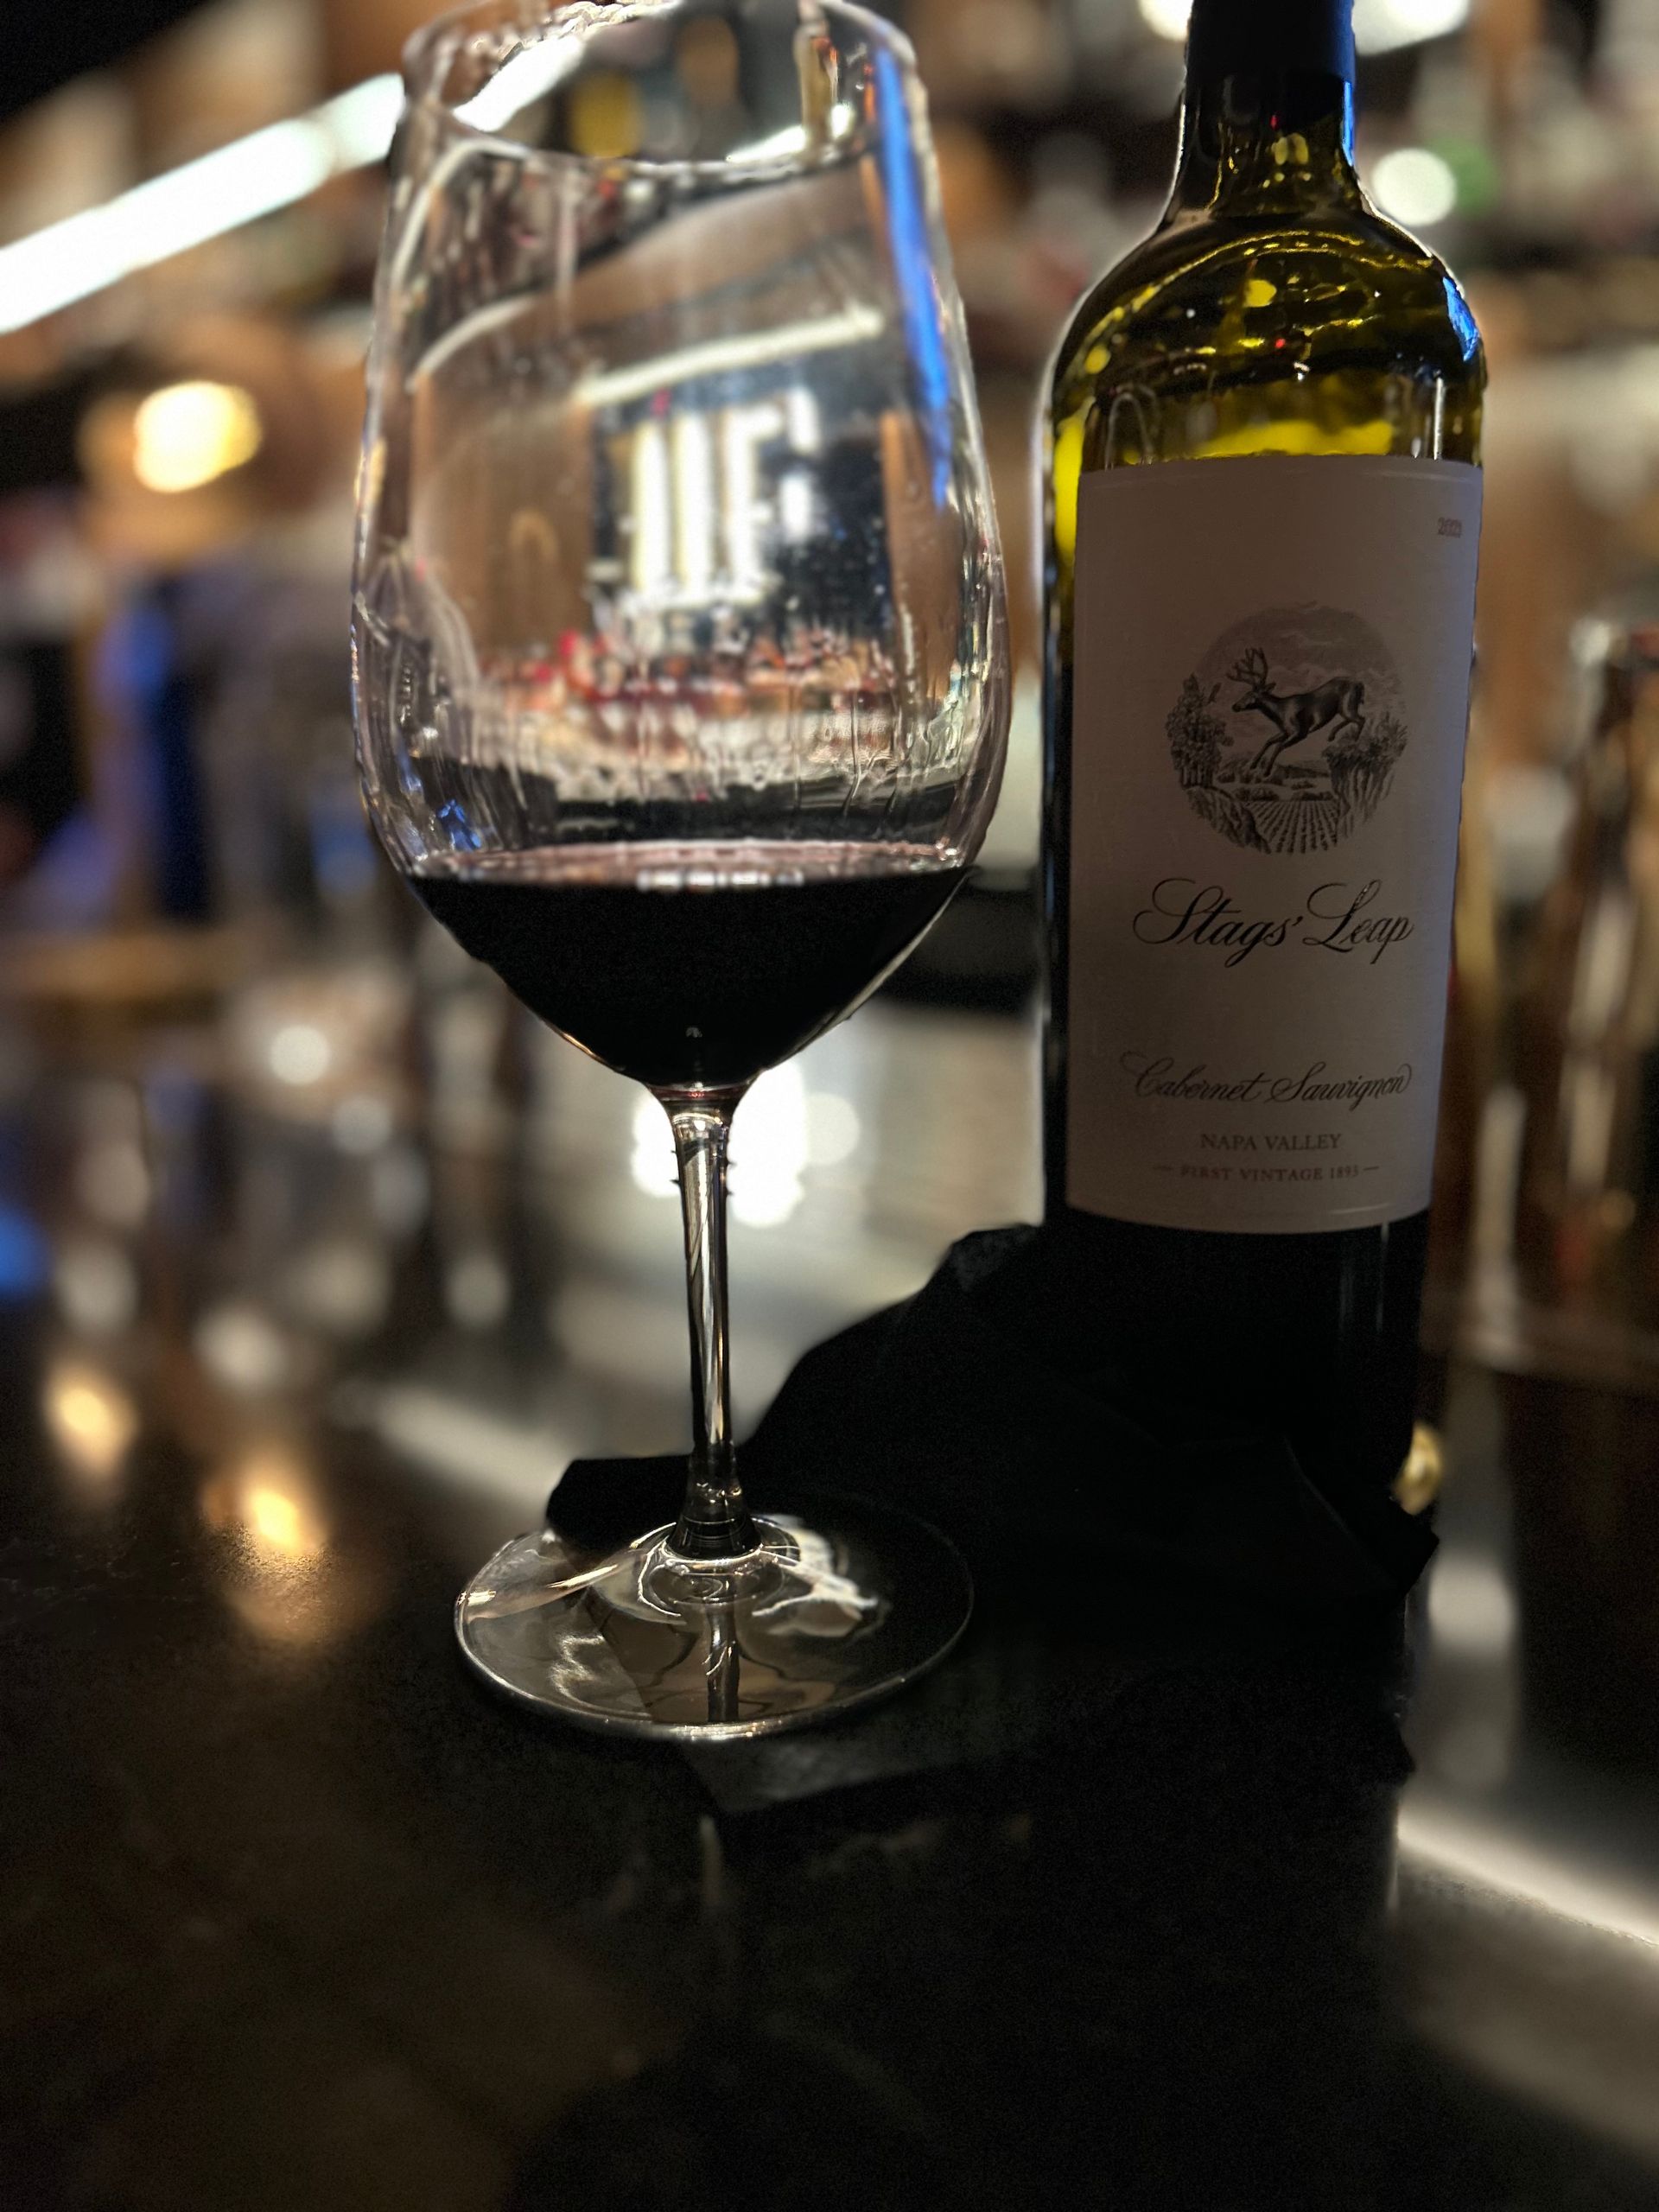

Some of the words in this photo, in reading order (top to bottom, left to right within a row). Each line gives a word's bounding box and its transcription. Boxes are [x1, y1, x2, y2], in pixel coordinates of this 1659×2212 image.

[1132, 877, 1303, 968] Stags'
[1302, 879, 1414, 964] Leap
[1120, 1051, 1268, 1102] Cabernet
[1265, 1061, 1412, 1111] Sauvignon
[1200, 1133, 1256, 1151] NAPA
[1264, 1133, 1342, 1151] VALLEY
[1179, 1166, 1231, 1181] FIRST
[1239, 1166, 1323, 1182] VINTAGE
